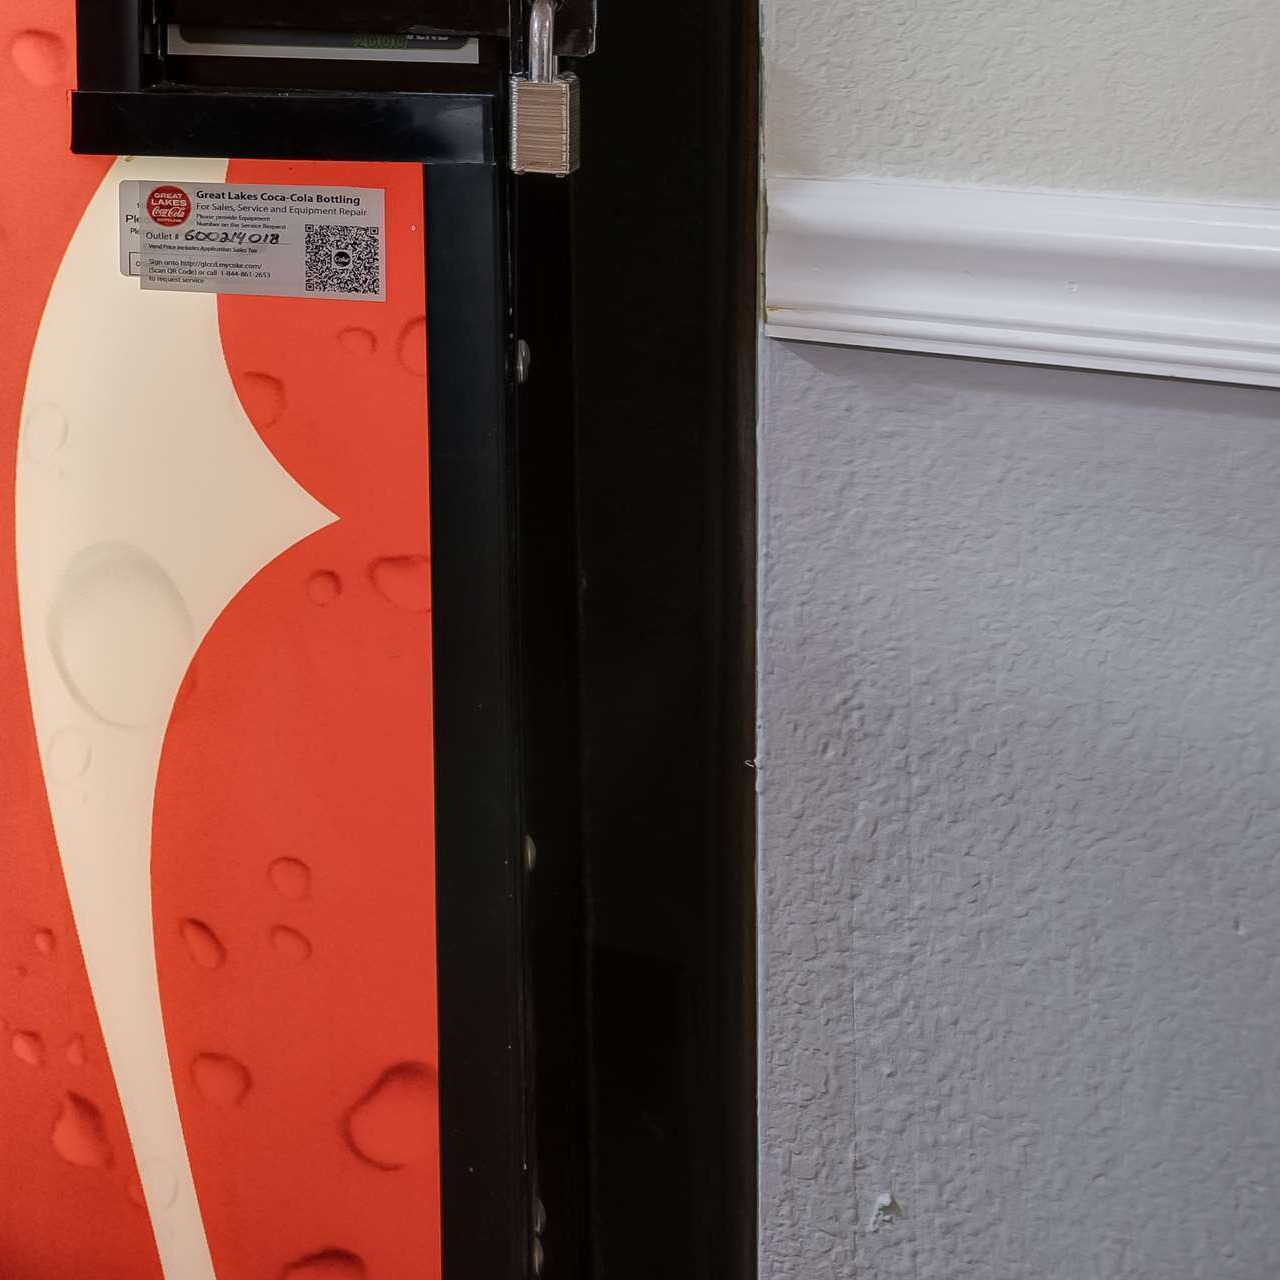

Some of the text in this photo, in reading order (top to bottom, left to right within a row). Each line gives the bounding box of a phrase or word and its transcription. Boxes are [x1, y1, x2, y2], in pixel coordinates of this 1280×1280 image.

[197, 190, 361, 206] Great Lakes Coca-Cola Bottling
[196, 203, 367, 216] For Sales, Service and Equipment Repair
[145, 232, 173, 240] Outlet
